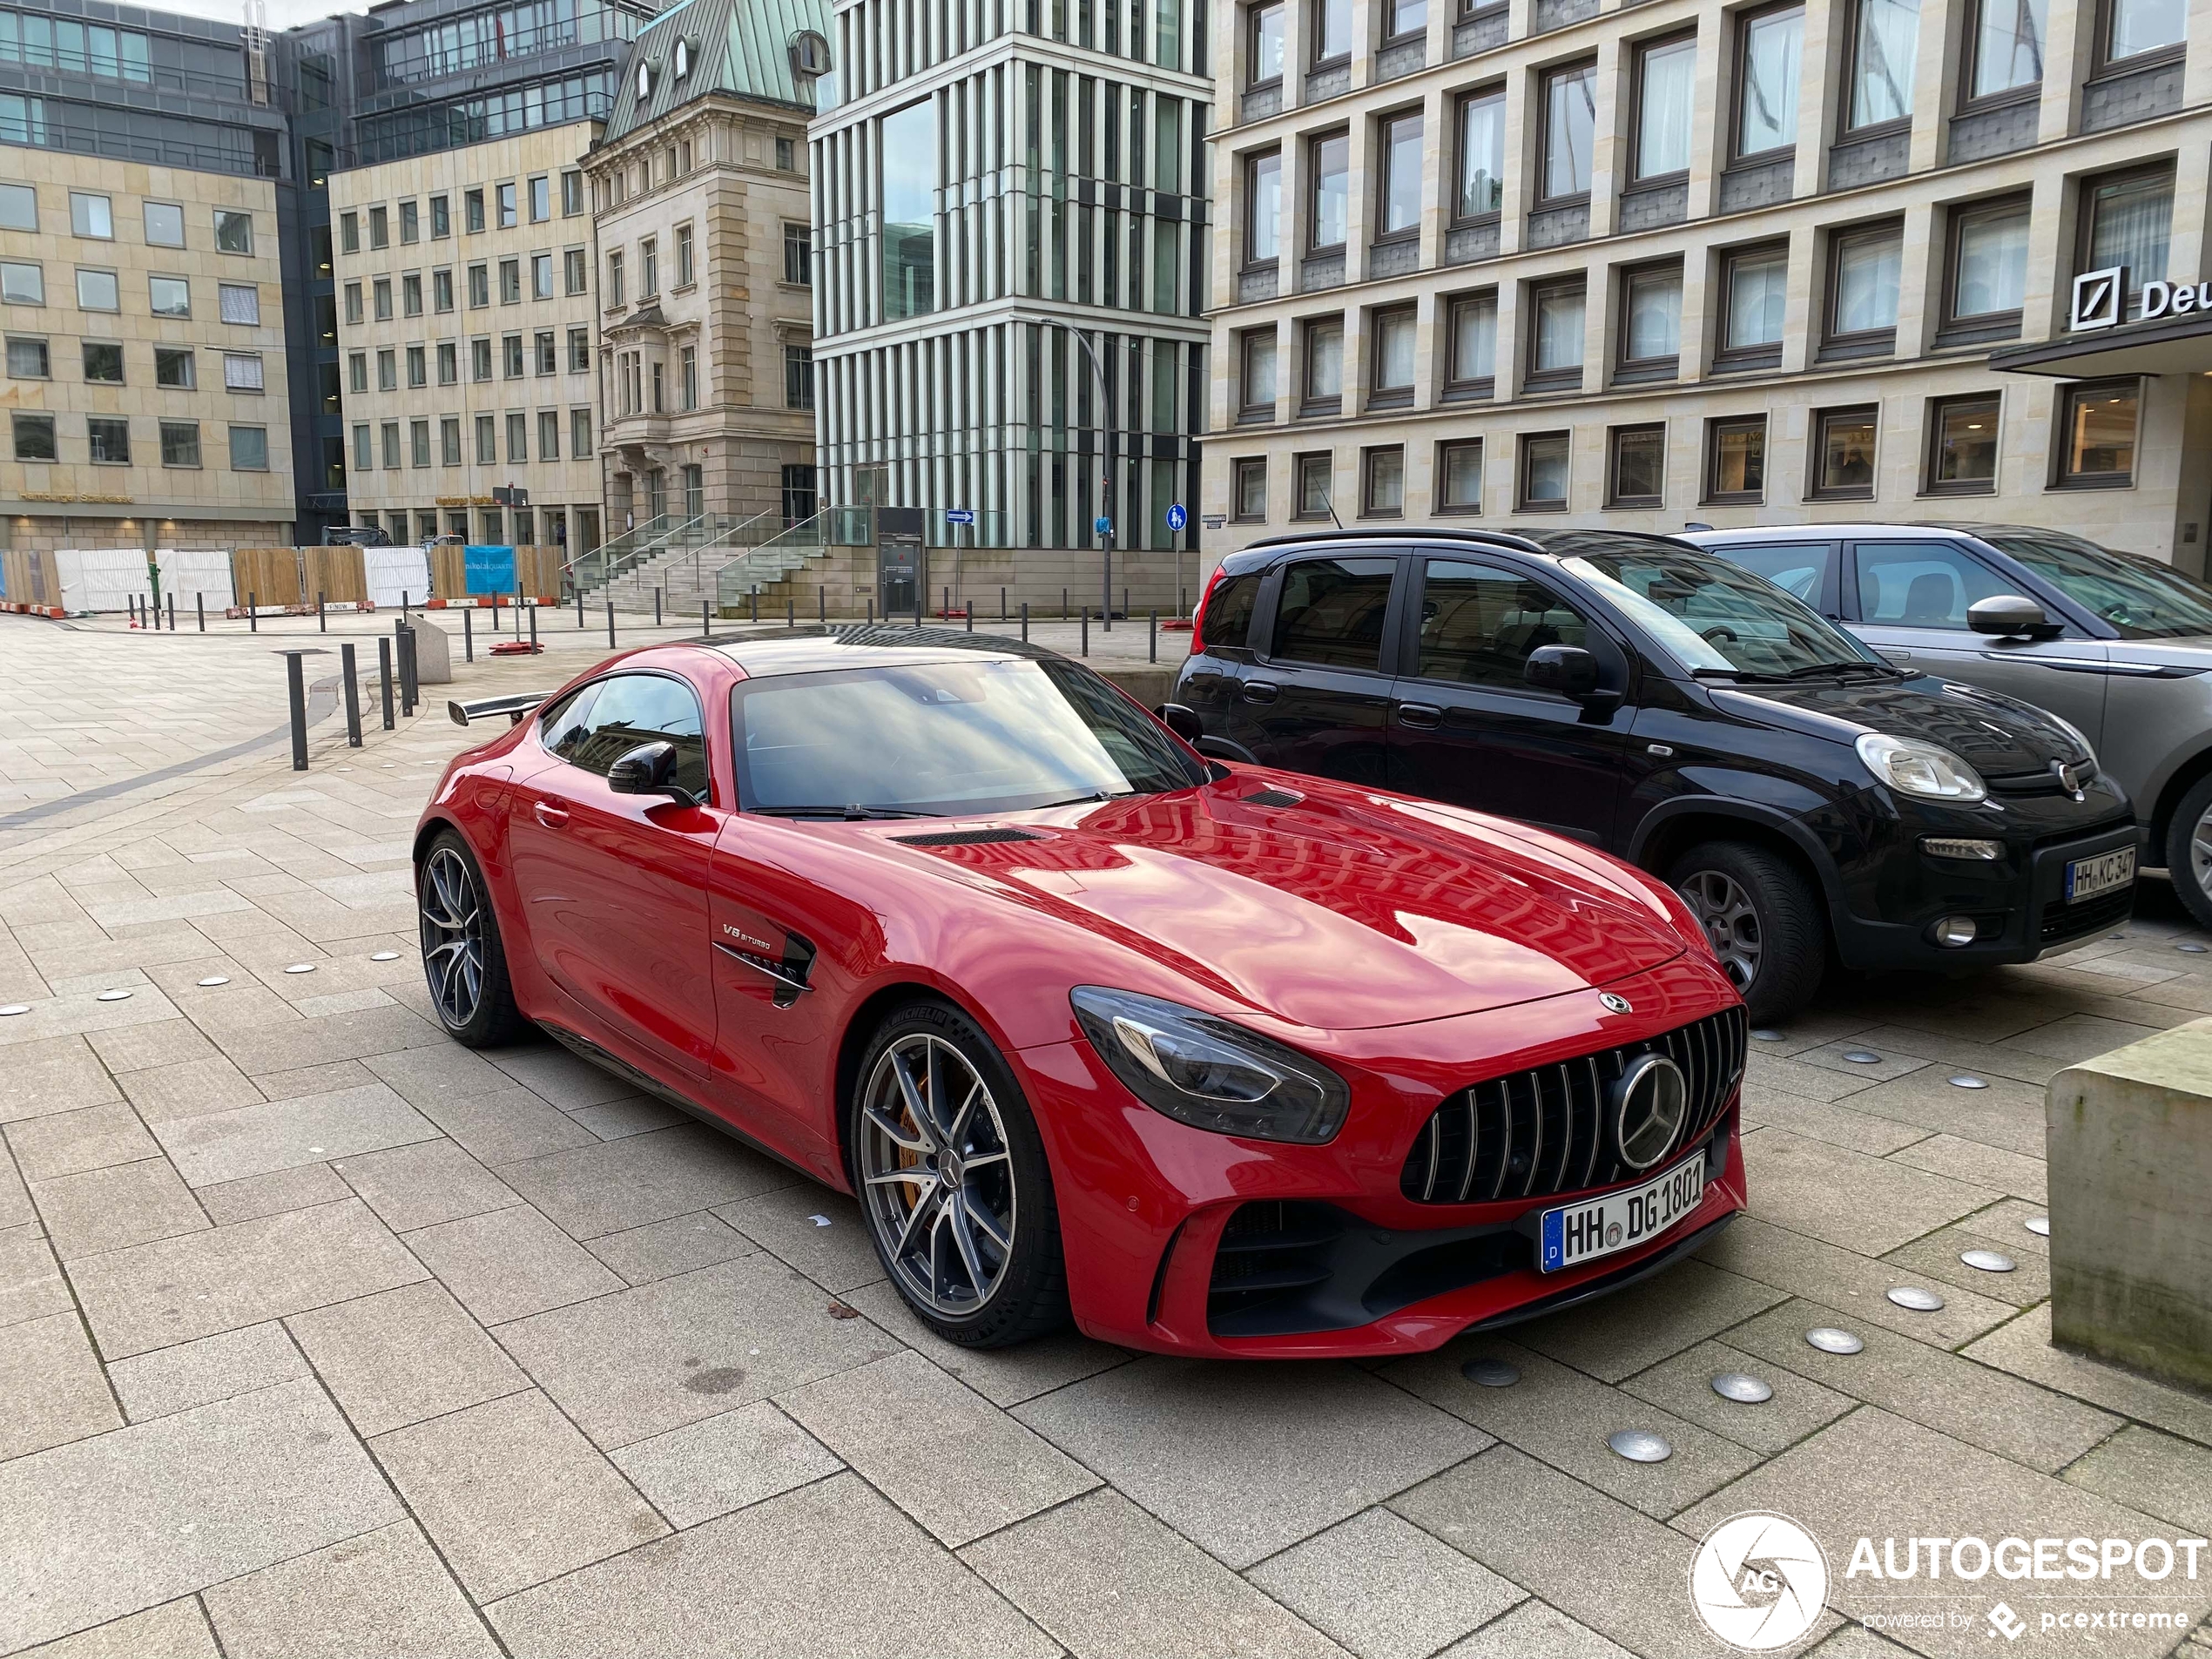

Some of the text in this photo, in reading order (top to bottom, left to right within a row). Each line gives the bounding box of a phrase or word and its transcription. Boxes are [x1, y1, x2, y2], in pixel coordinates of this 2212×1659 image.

[19, 492, 133, 502] Hamburger Sparkasse
[2075, 863, 2093, 893] HH
[2100, 857, 2114, 886] KC
[2115, 851, 2134, 880] 347
[723, 923, 771, 950] V8 BITURBO
[891, 1007, 948, 1025] MICHELIN
[1566, 1160, 1701, 1258] HH DG 1801
[1549, 1245, 1558, 1259] D
